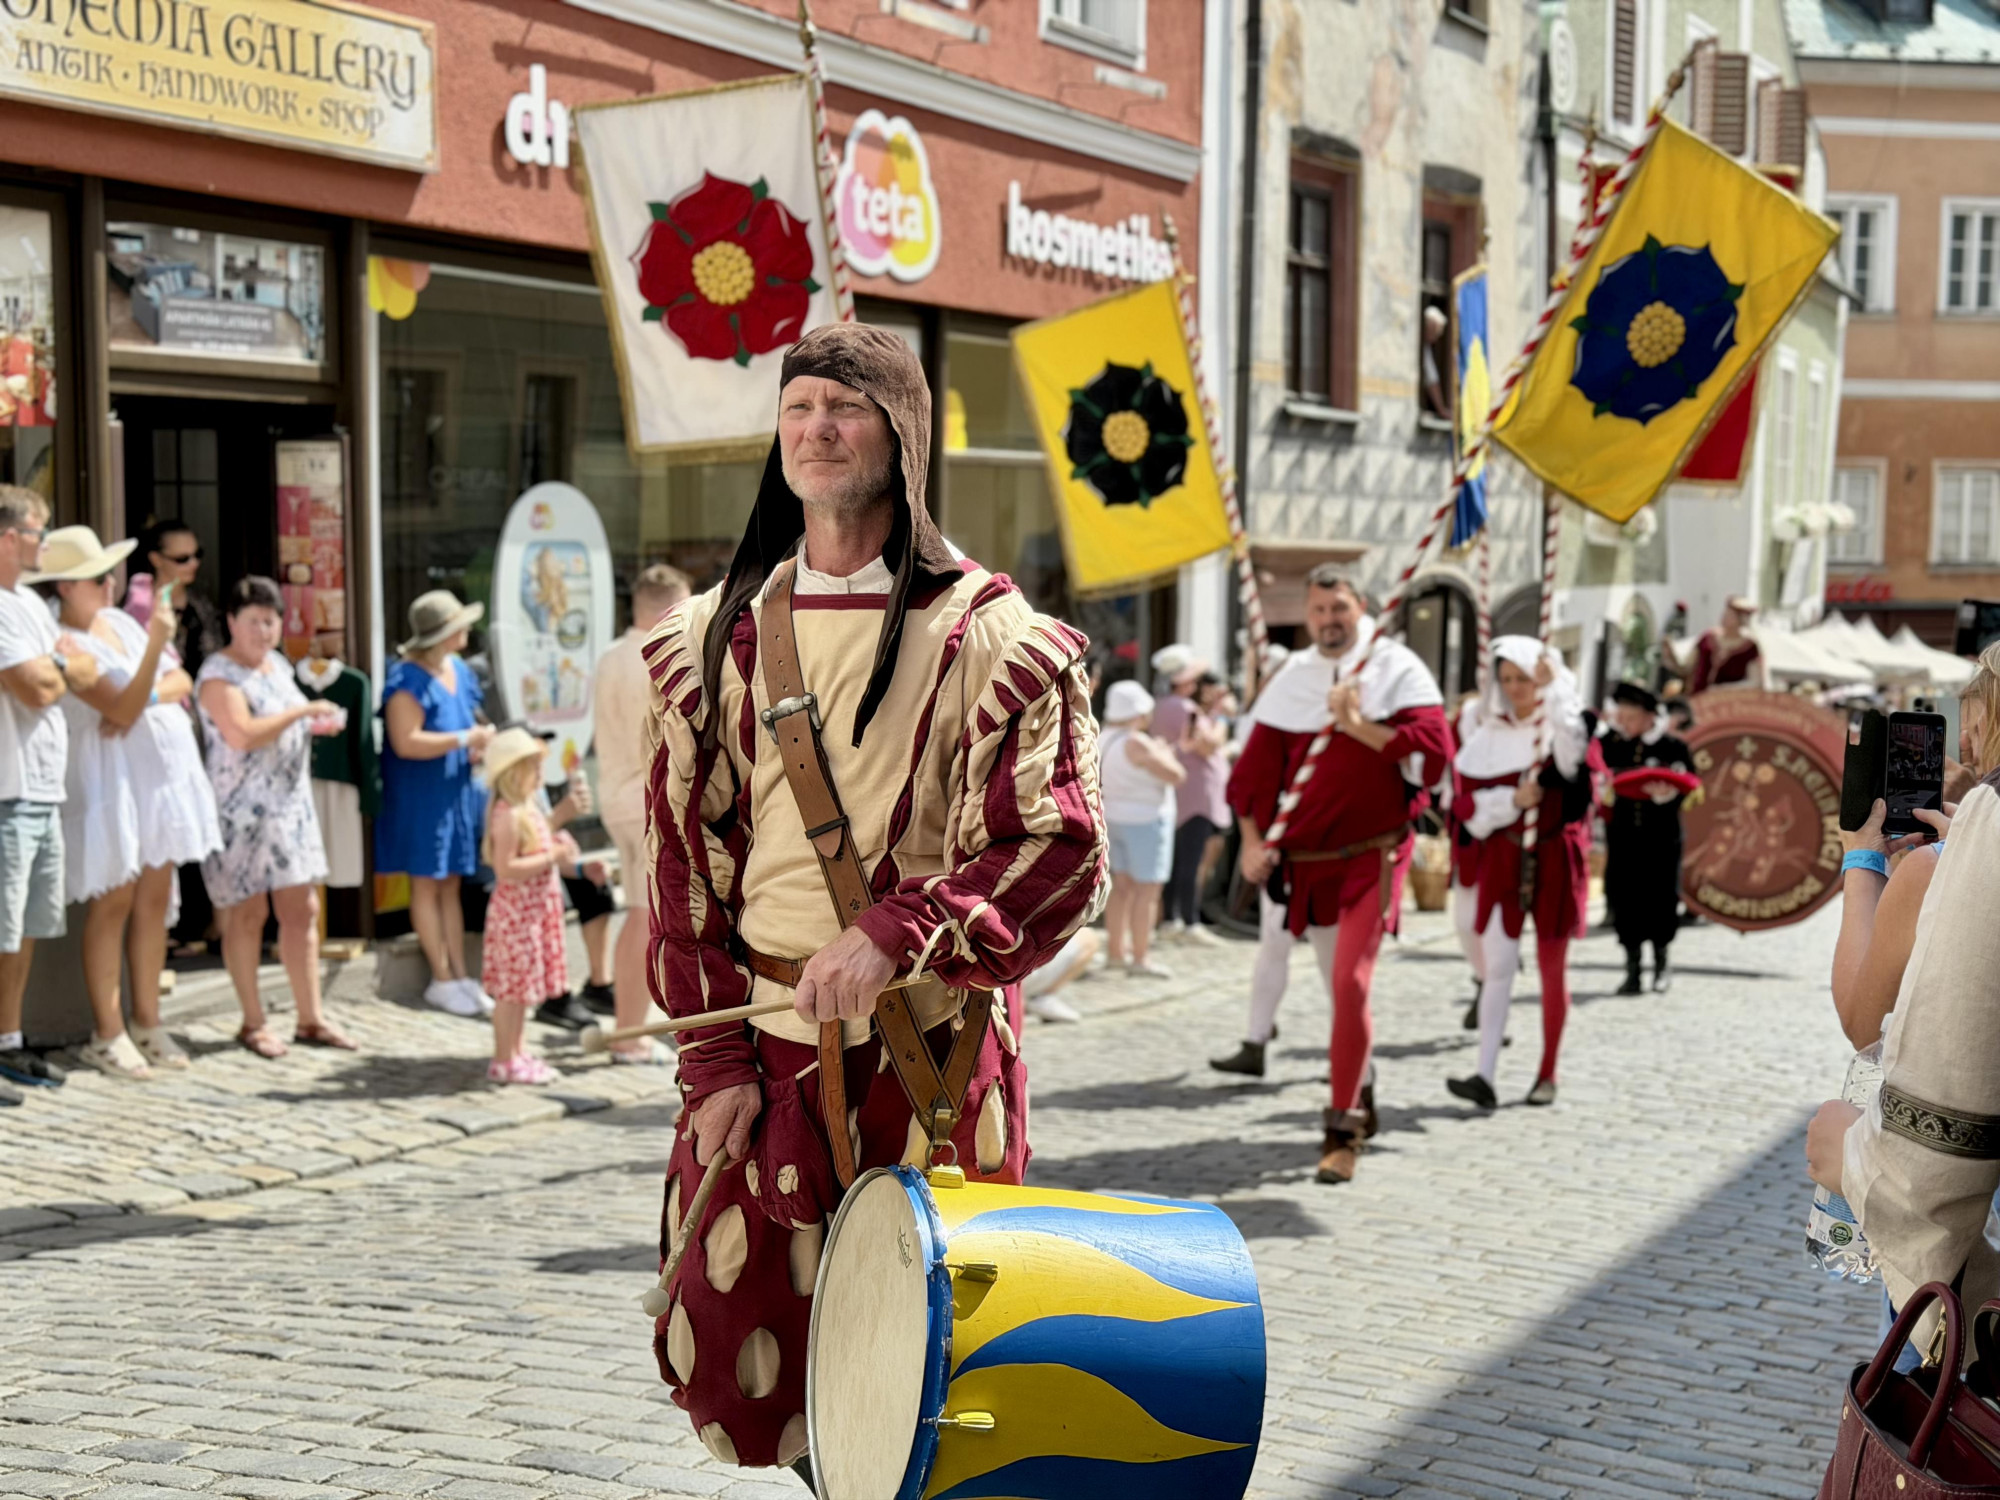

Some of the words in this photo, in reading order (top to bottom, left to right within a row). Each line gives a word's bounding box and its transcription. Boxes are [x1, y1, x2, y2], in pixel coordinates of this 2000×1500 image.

[15, 37, 119, 92] ANTIK
[138, 60, 304, 127] HANDWORK
[319, 96, 385, 138] SHOP
[223, 12, 416, 113] GALLERY
[852, 174, 926, 242] teta
